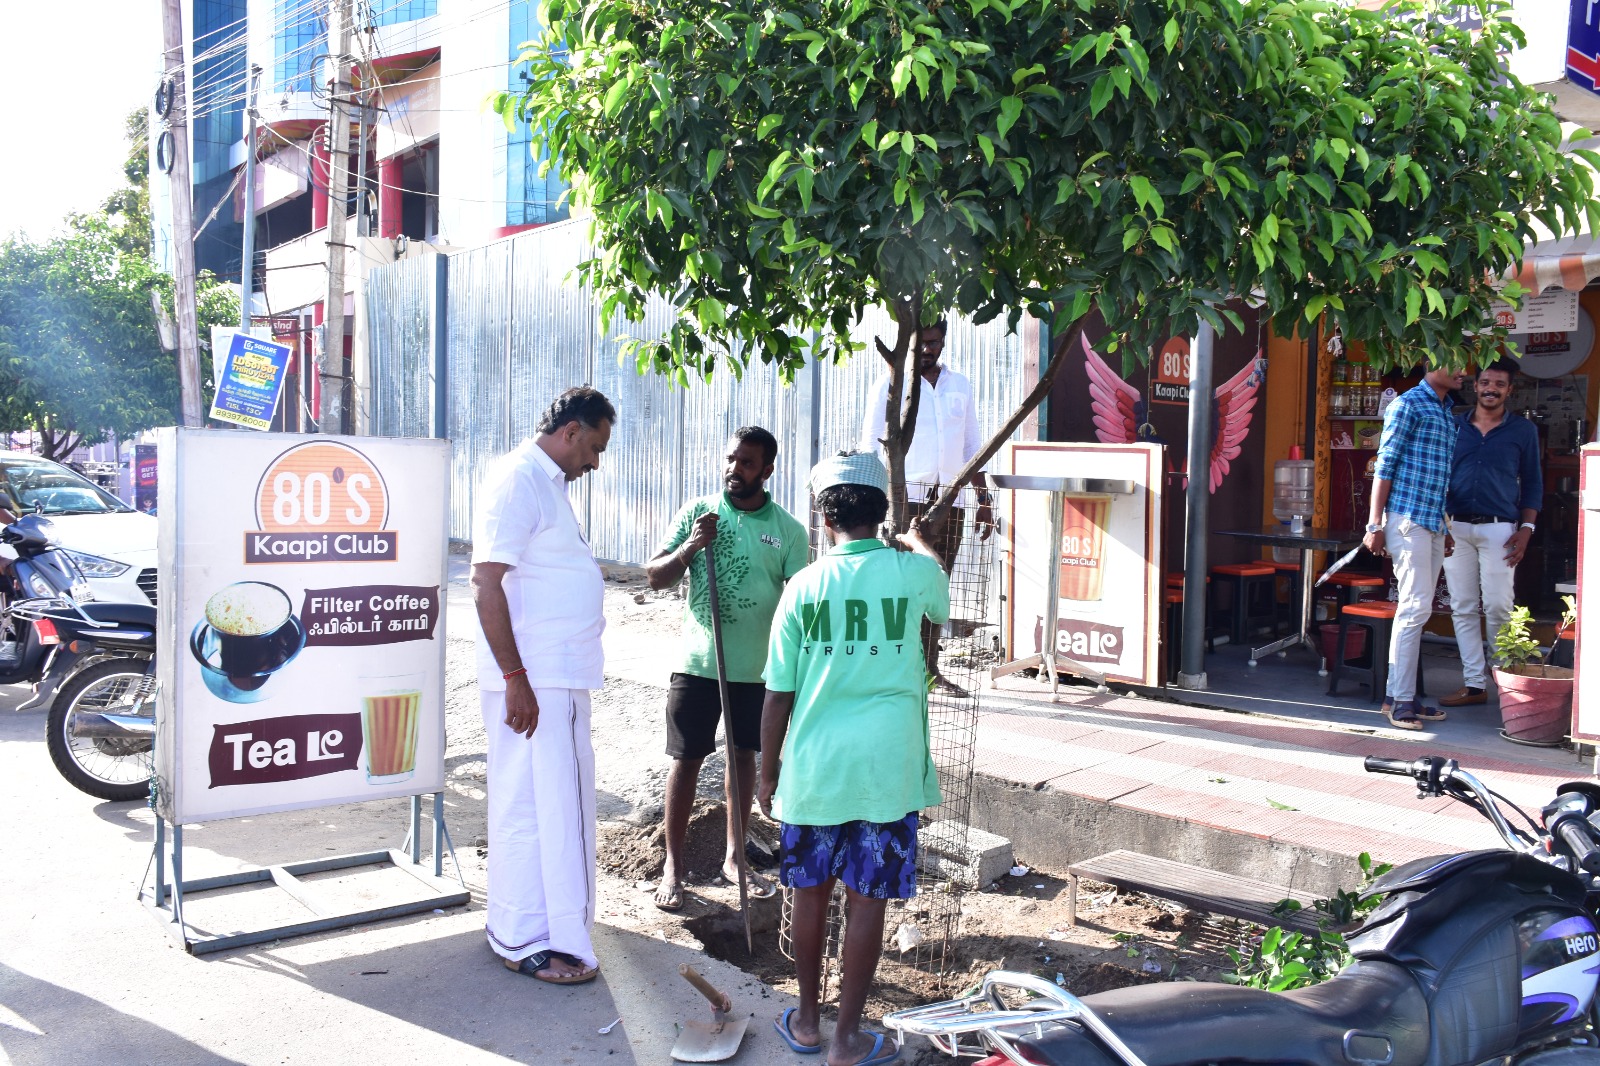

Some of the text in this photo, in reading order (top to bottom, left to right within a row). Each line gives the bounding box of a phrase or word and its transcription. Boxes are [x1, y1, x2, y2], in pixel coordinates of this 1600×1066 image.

[254, 343, 277, 354] SQUARE
[1155, 383, 1178, 400] Kaapi
[215, 409, 268, 428] 89397 40001
[254, 534, 389, 560] Kaapi Club
[1061, 557, 1097, 568] aapi Club
[311, 595, 430, 614] Filter Coffee
[309, 614, 428, 636] ஃபில்டர் காபி
[803, 644, 903, 656] TRUST
[224, 729, 345, 771] Tea டீ
[1565, 934, 1596, 955] Hero
